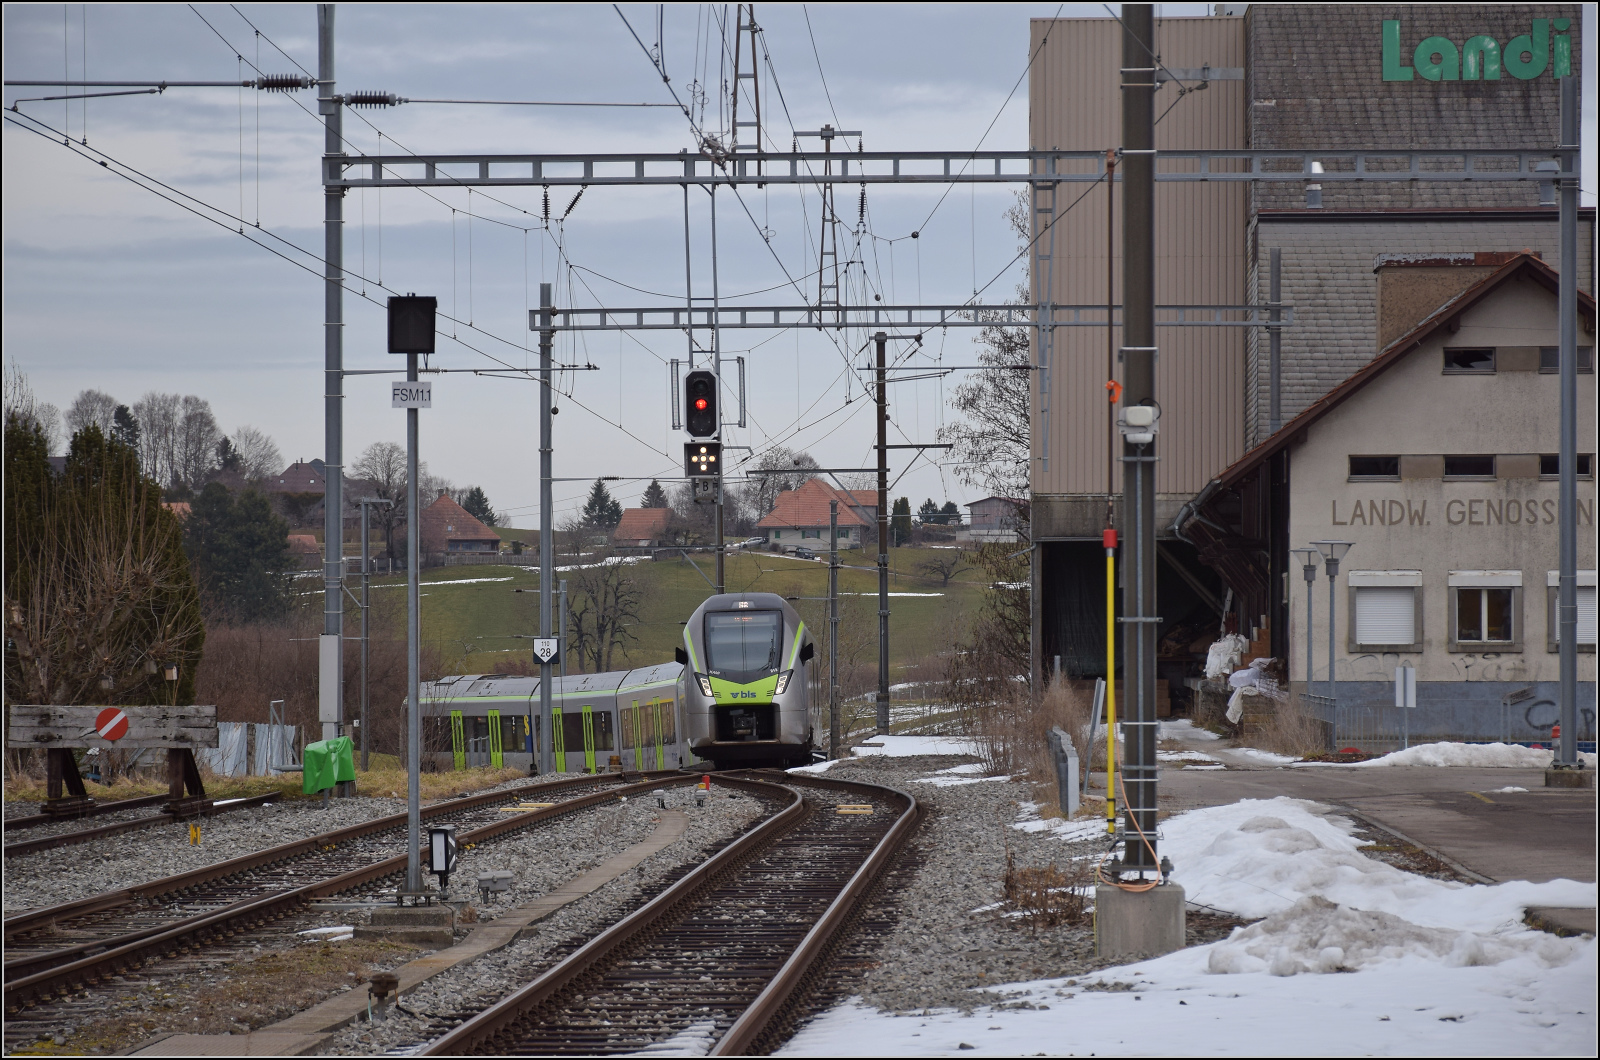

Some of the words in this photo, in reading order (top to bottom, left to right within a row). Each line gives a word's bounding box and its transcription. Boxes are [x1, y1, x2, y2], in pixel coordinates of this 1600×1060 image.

[1382, 18, 1571, 82] Landi
[392, 388, 431, 402] FSM1.1
[702, 481, 709, 492] B
[1332, 499, 1431, 526] LANDW.
[1446, 499, 1594, 526] GENOSSN
[540, 647, 551, 658] 28
[740, 690, 757, 699] bls
